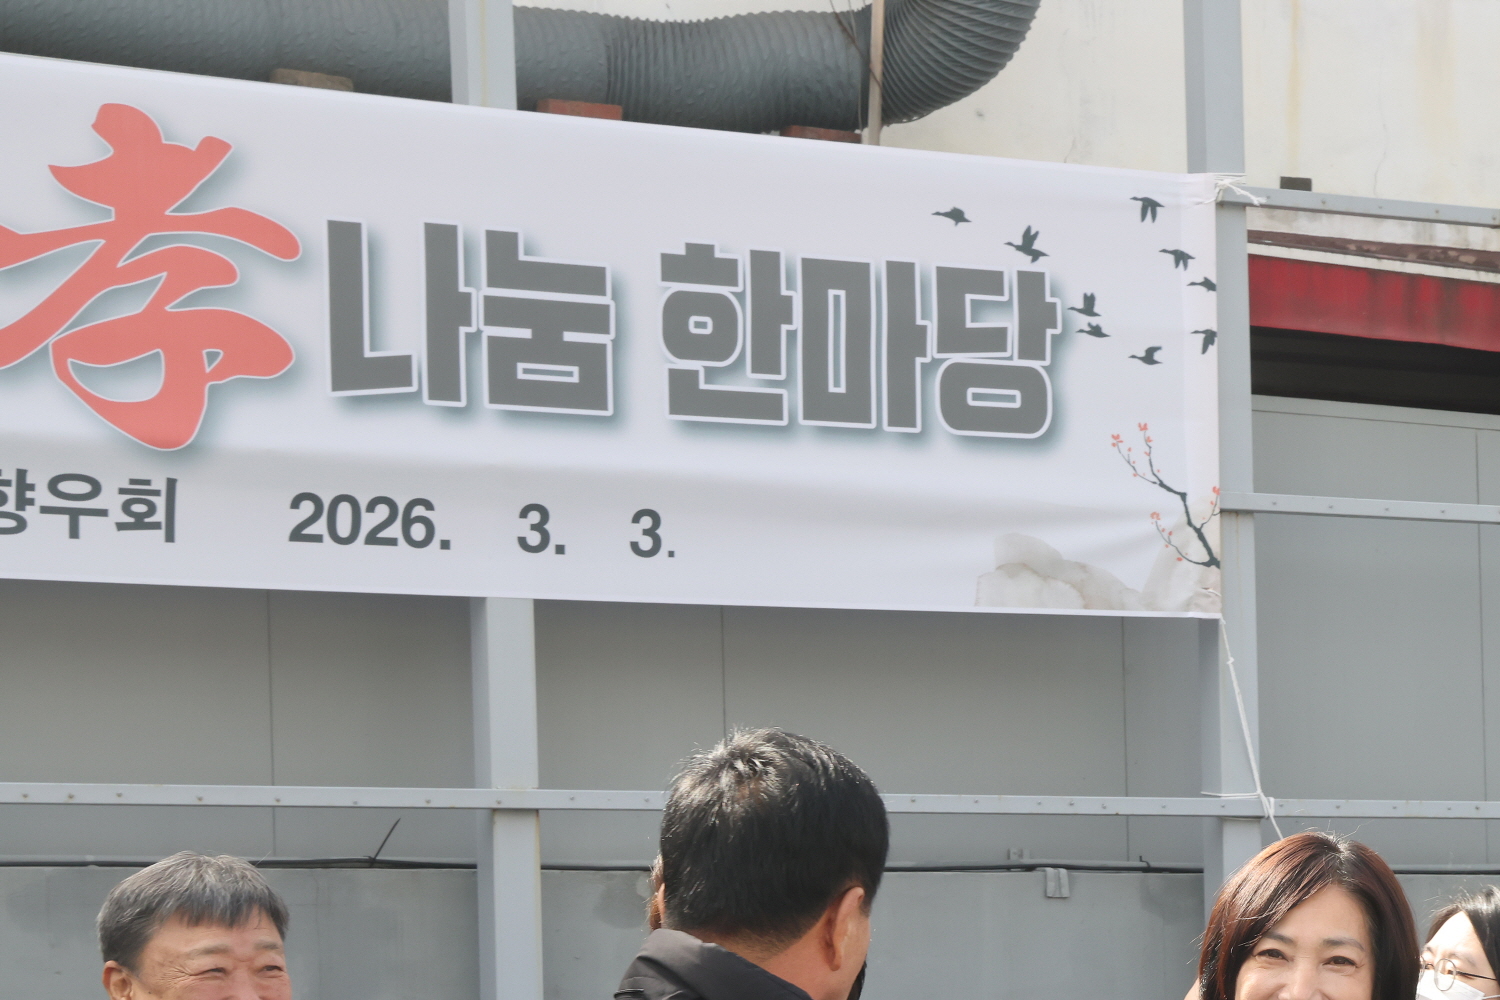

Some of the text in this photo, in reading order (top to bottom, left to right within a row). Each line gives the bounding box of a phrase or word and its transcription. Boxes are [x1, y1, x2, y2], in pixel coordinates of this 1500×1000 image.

[327, 220, 1061, 436] 나눔 한마당
[288, 491, 451, 551] 2026.
[517, 503, 566, 555] 3.
[629, 508, 675, 559] 3.
